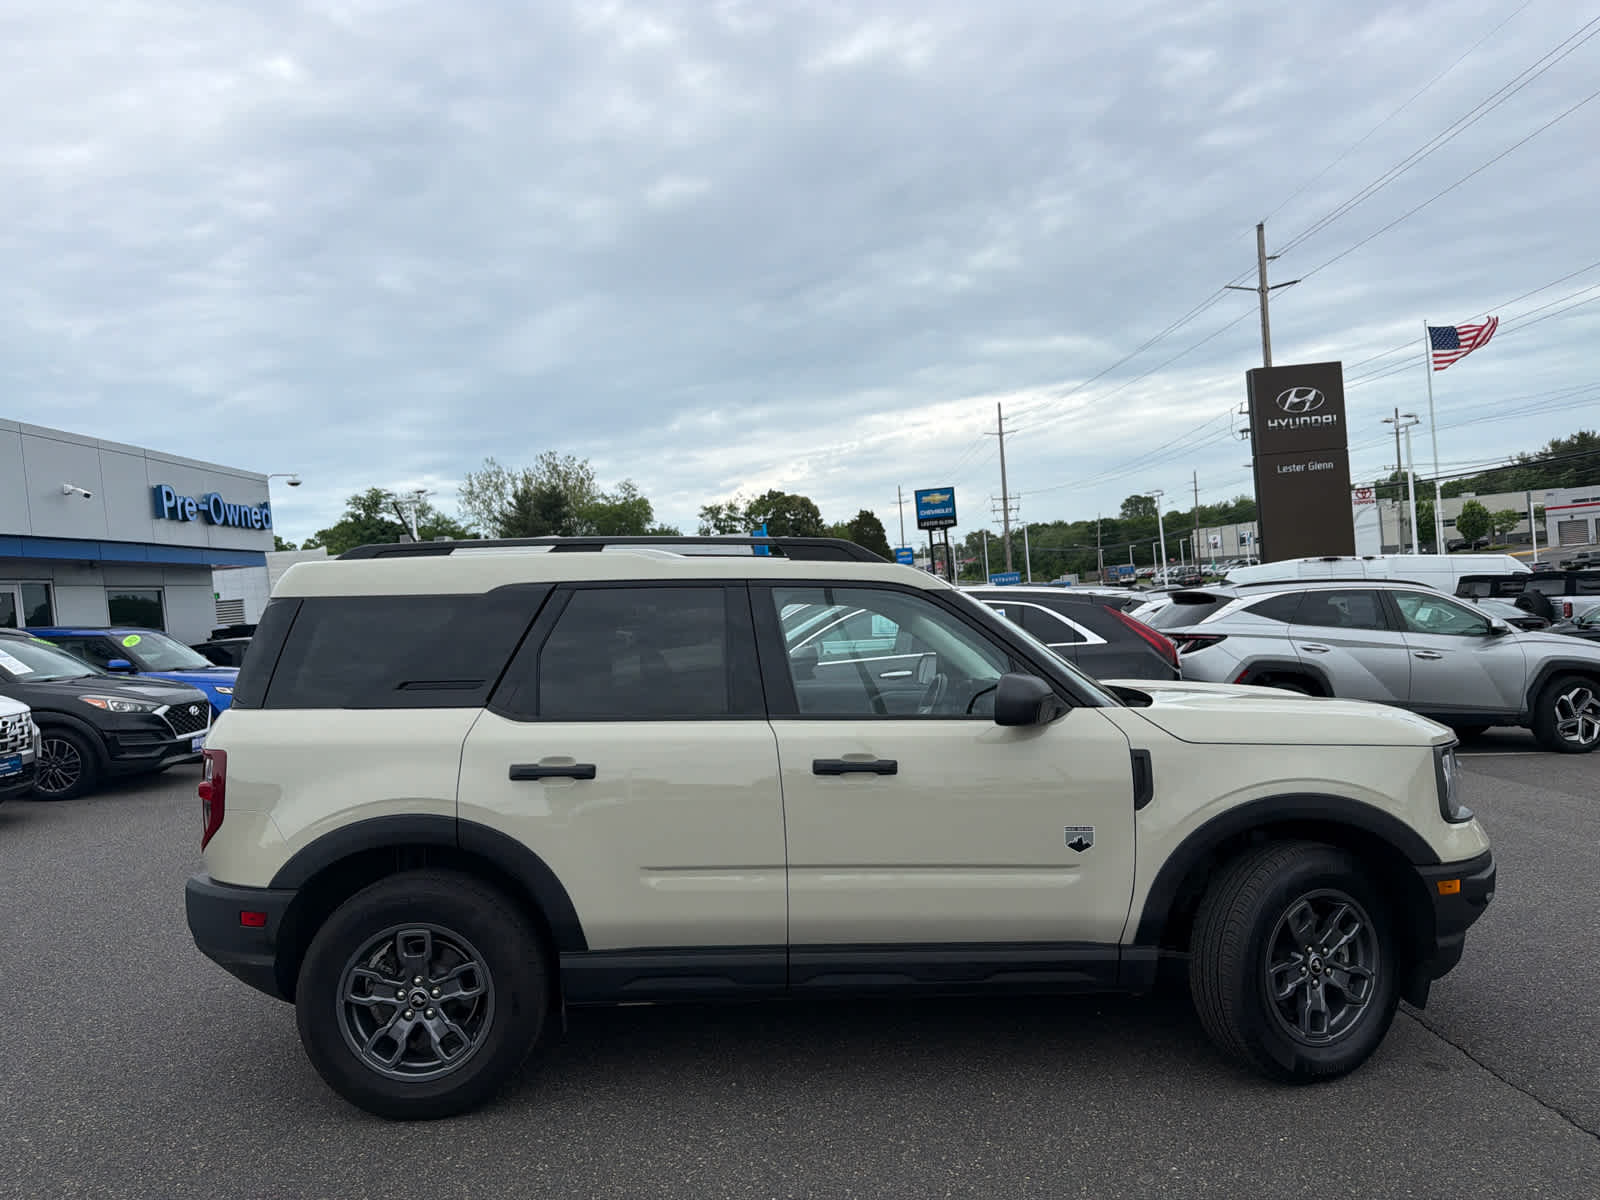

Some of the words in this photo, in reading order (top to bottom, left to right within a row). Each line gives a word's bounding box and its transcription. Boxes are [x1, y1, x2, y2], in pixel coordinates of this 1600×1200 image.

[1267, 414, 1337, 429] HYUNDAI
[1277, 463, 1306, 473] Lester
[1308, 461, 1334, 470] Glenn
[155, 485, 273, 529] Pre-Owned
[920, 508, 953, 516] CHEVROLET
